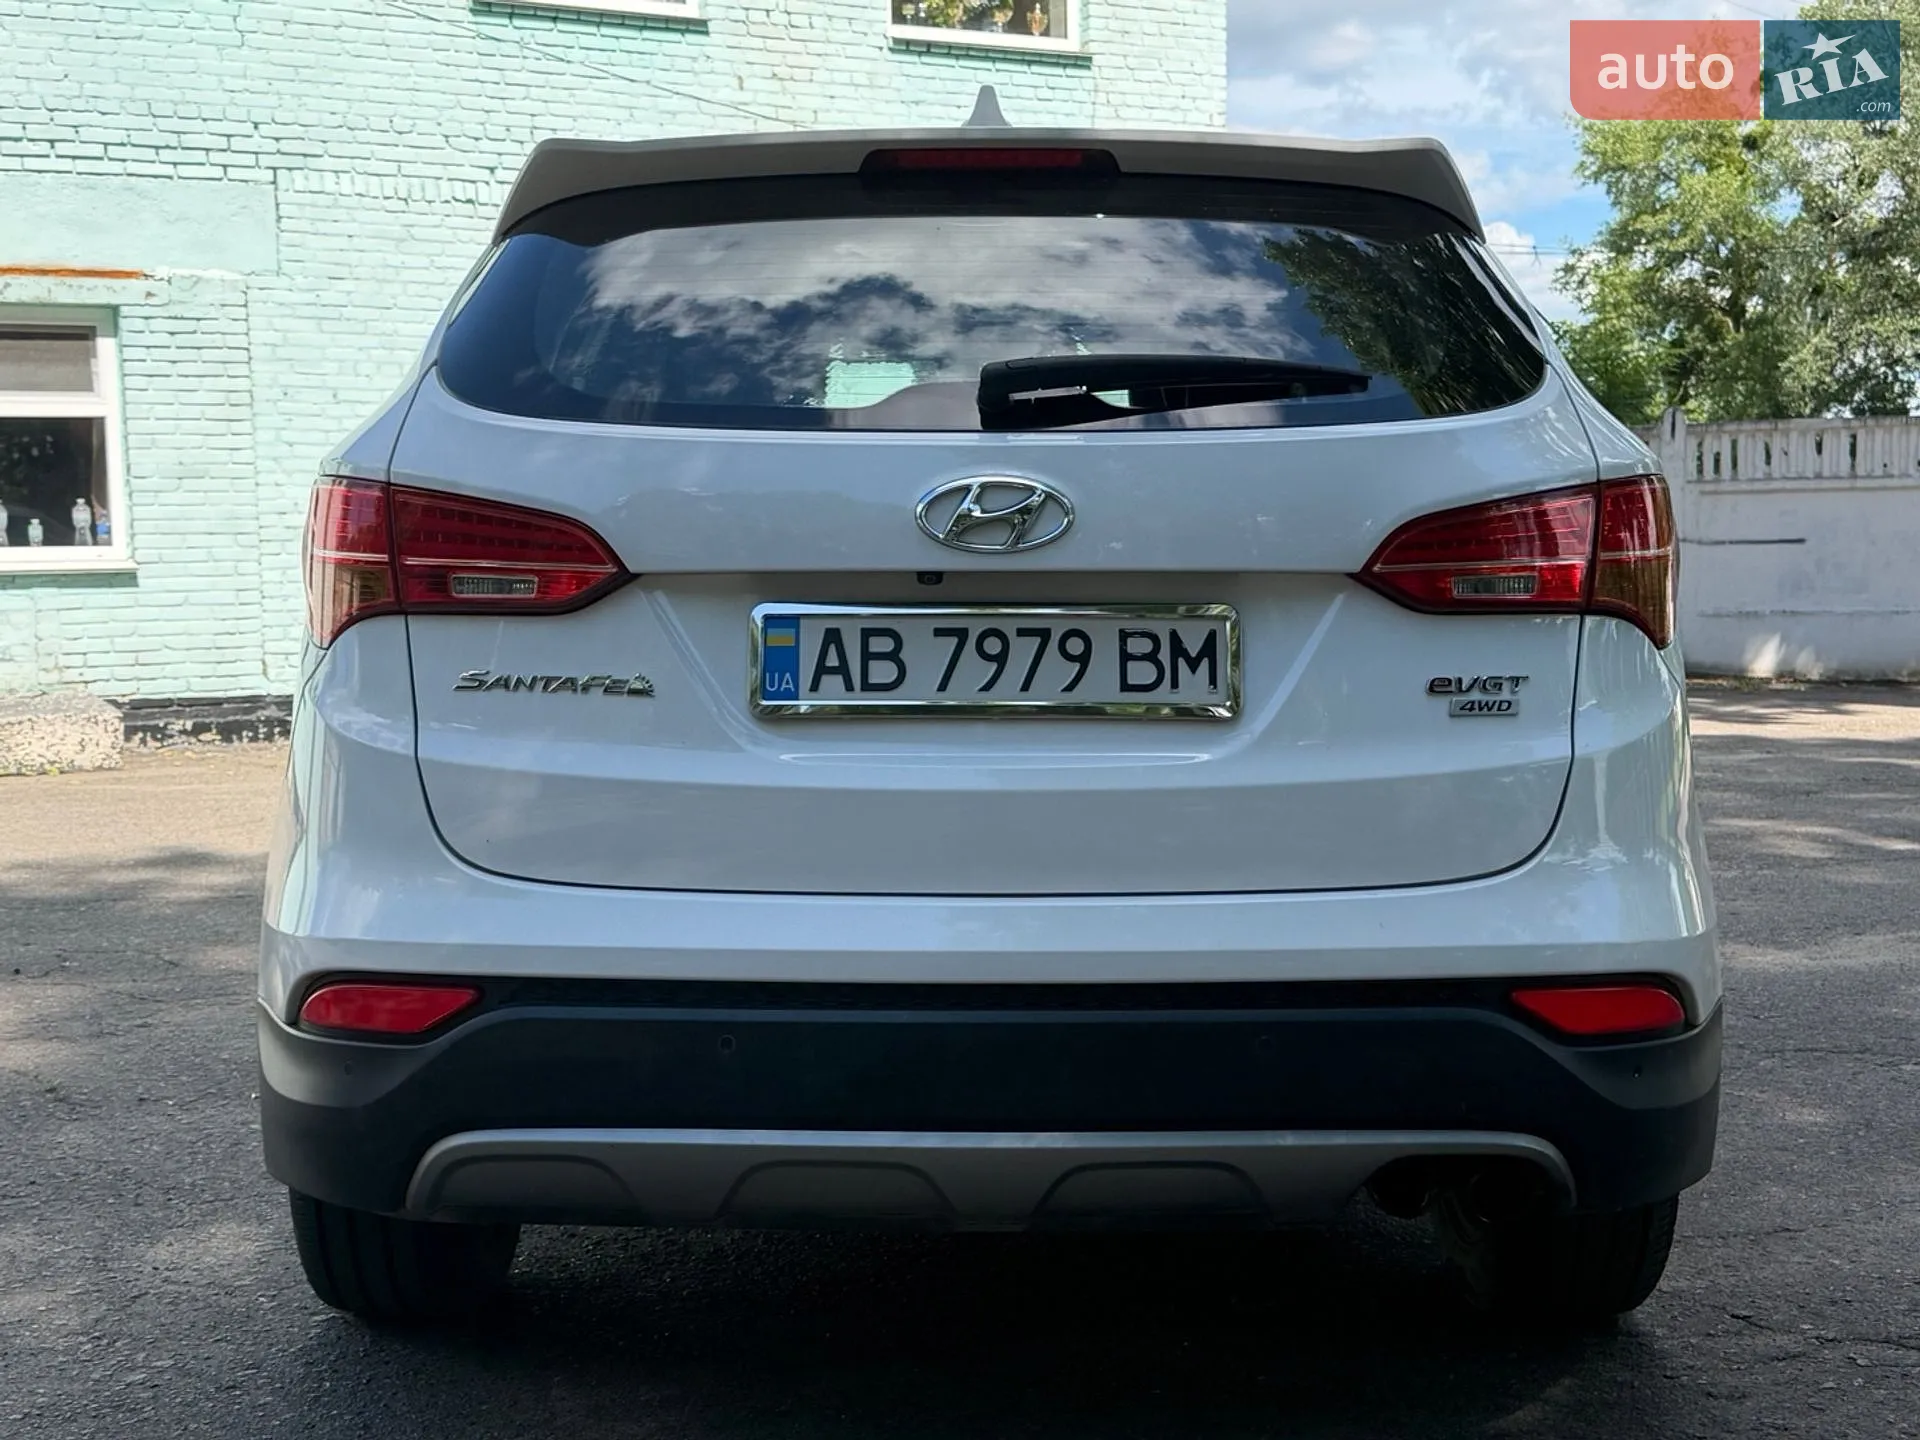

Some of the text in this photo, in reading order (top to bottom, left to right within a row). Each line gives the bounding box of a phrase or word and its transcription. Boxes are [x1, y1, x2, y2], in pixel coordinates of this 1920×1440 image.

[808, 627, 1218, 694] AB 7979 BM
[765, 672, 795, 692] UA
[1459, 699, 1512, 713] 4WD
